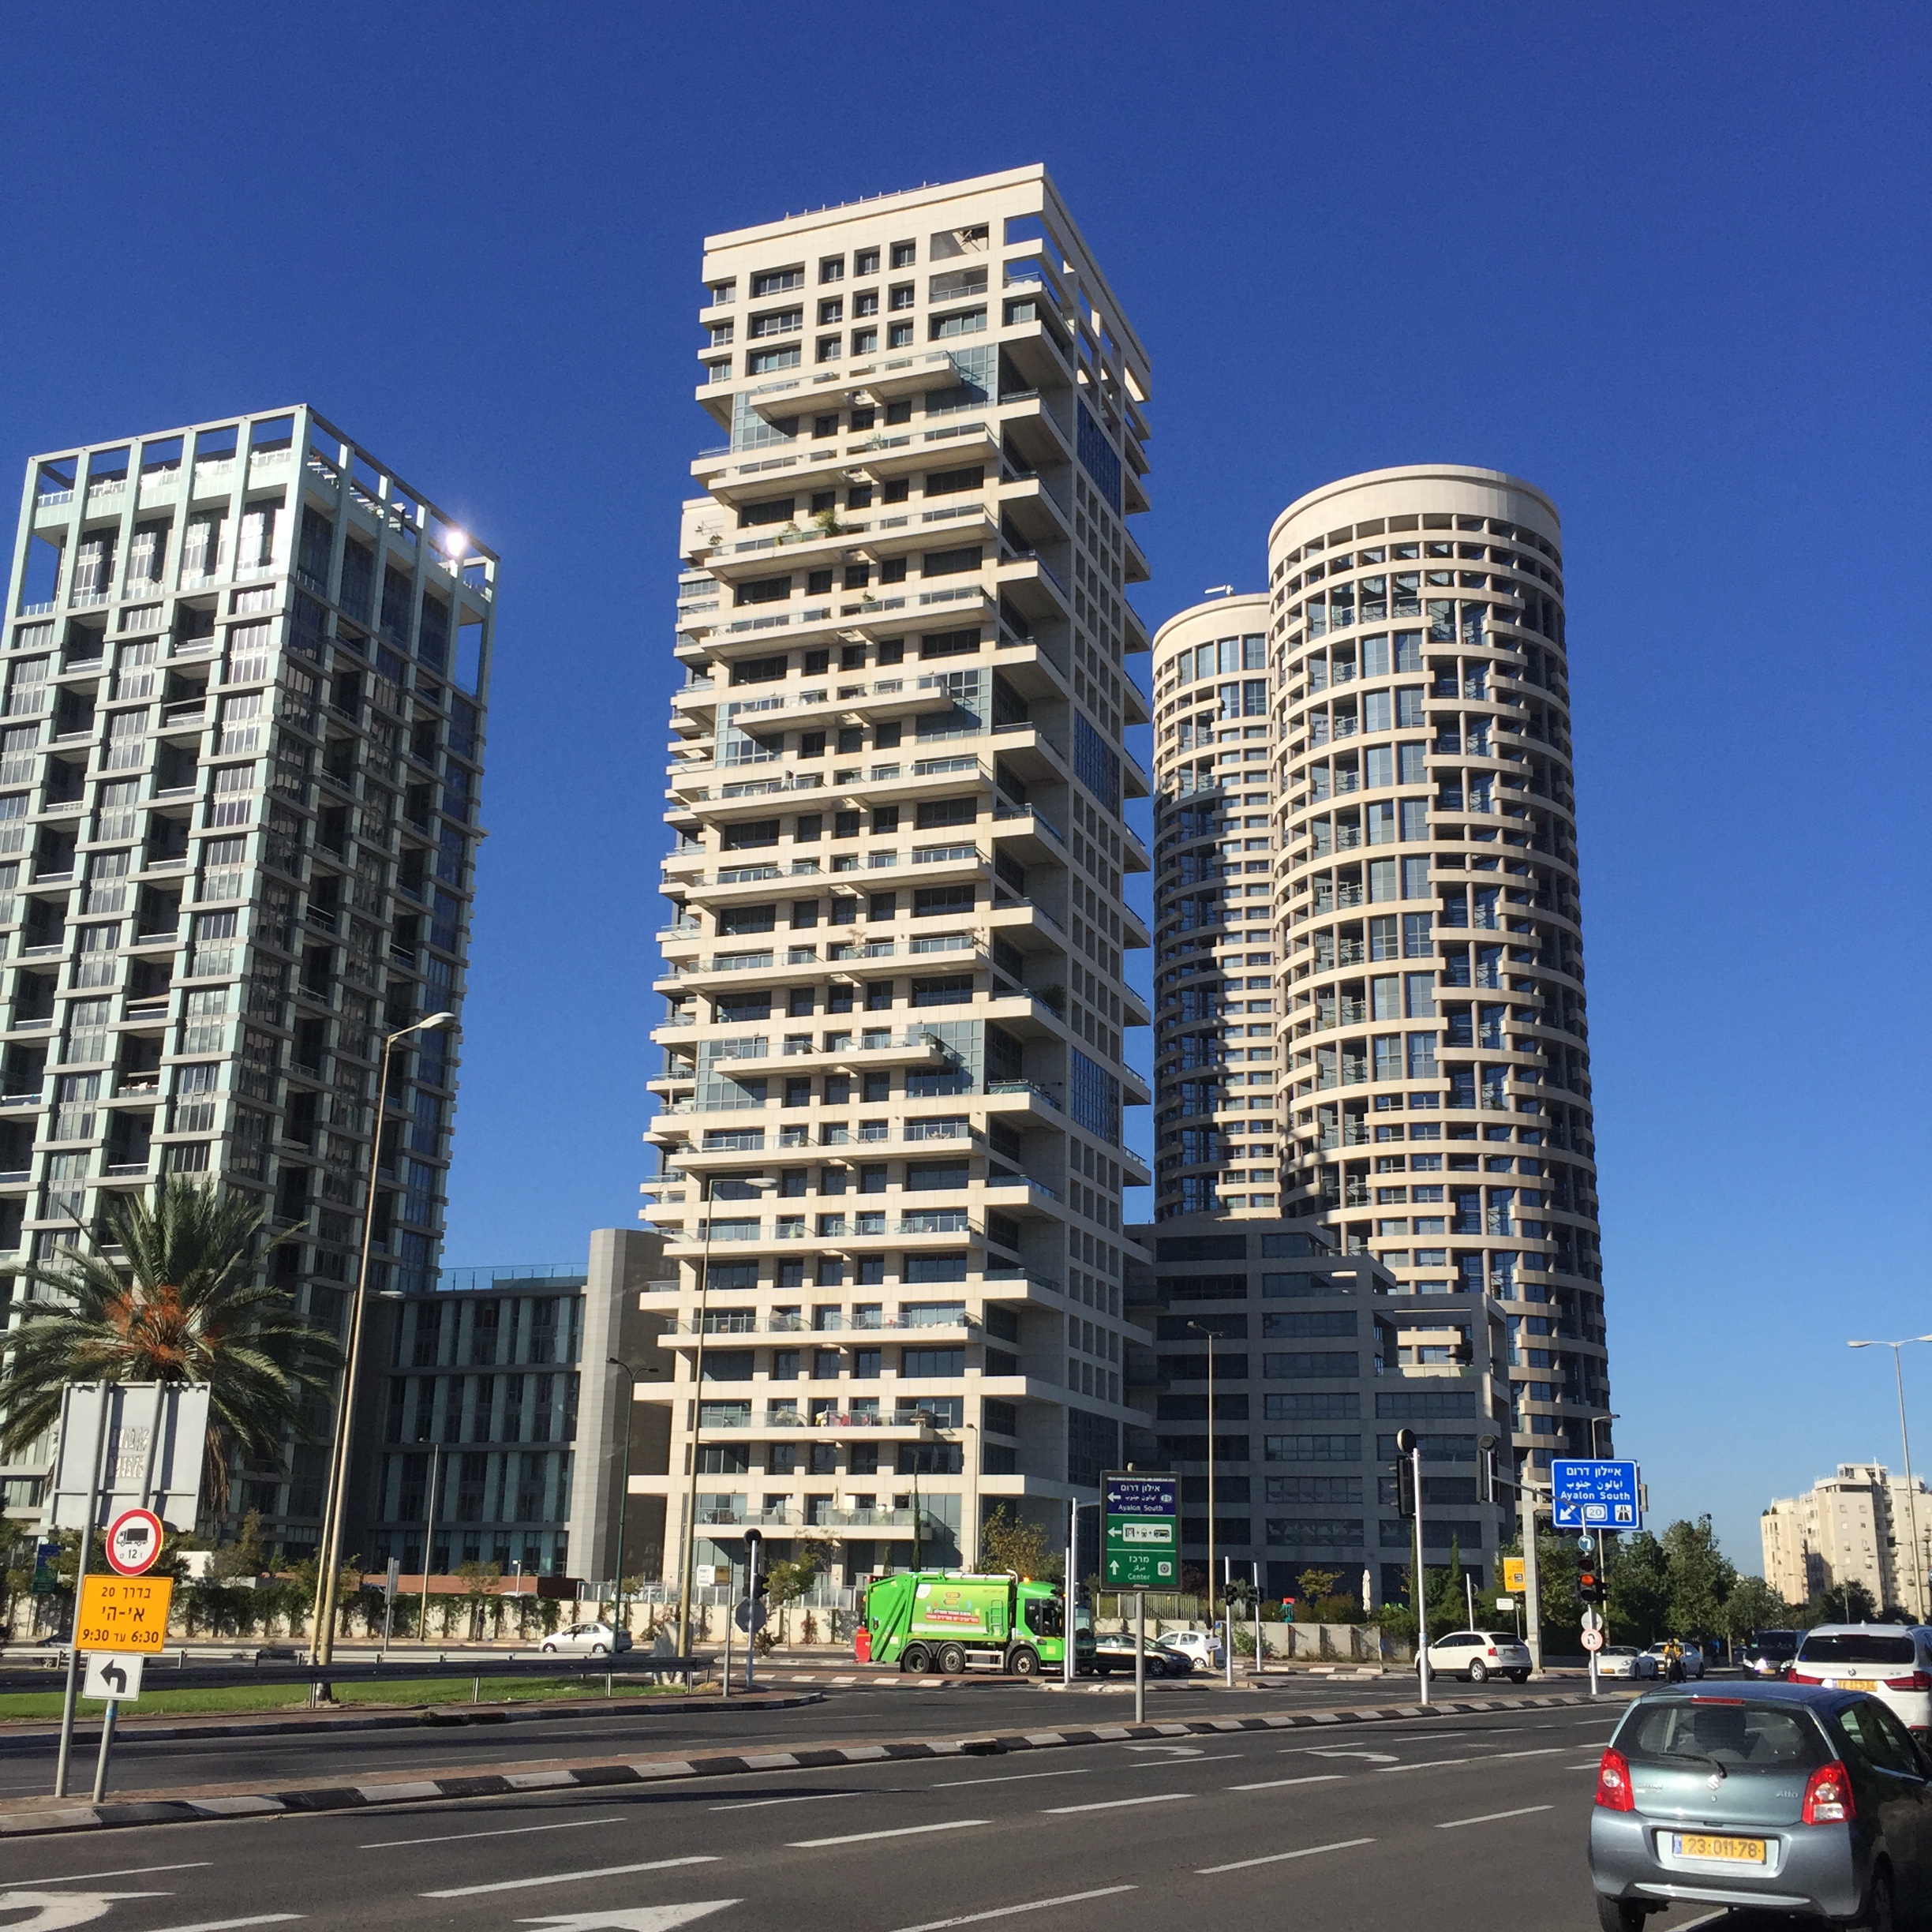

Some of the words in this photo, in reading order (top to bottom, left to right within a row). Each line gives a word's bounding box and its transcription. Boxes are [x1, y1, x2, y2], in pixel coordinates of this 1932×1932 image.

[1566, 1467, 1590, 1476] דרום
[1594, 1466, 1622, 1478] איילון
[1566, 1480, 1591, 1491] جنوب
[1560, 1491, 1595, 1501] Ayalon
[1600, 1492, 1631, 1500] South
[1118, 1503, 1141, 1512] Ayalon
[128, 1549, 137, 1559] 12
[101, 1586, 115, 1597] 20
[122, 1587, 151, 1599] בדרך
[82, 1628, 110, 1642] 9:30
[114, 1633, 126, 1642] עד
[131, 1631, 159, 1643] 6:30
[1776, 1789, 1799, 1799] Alto
